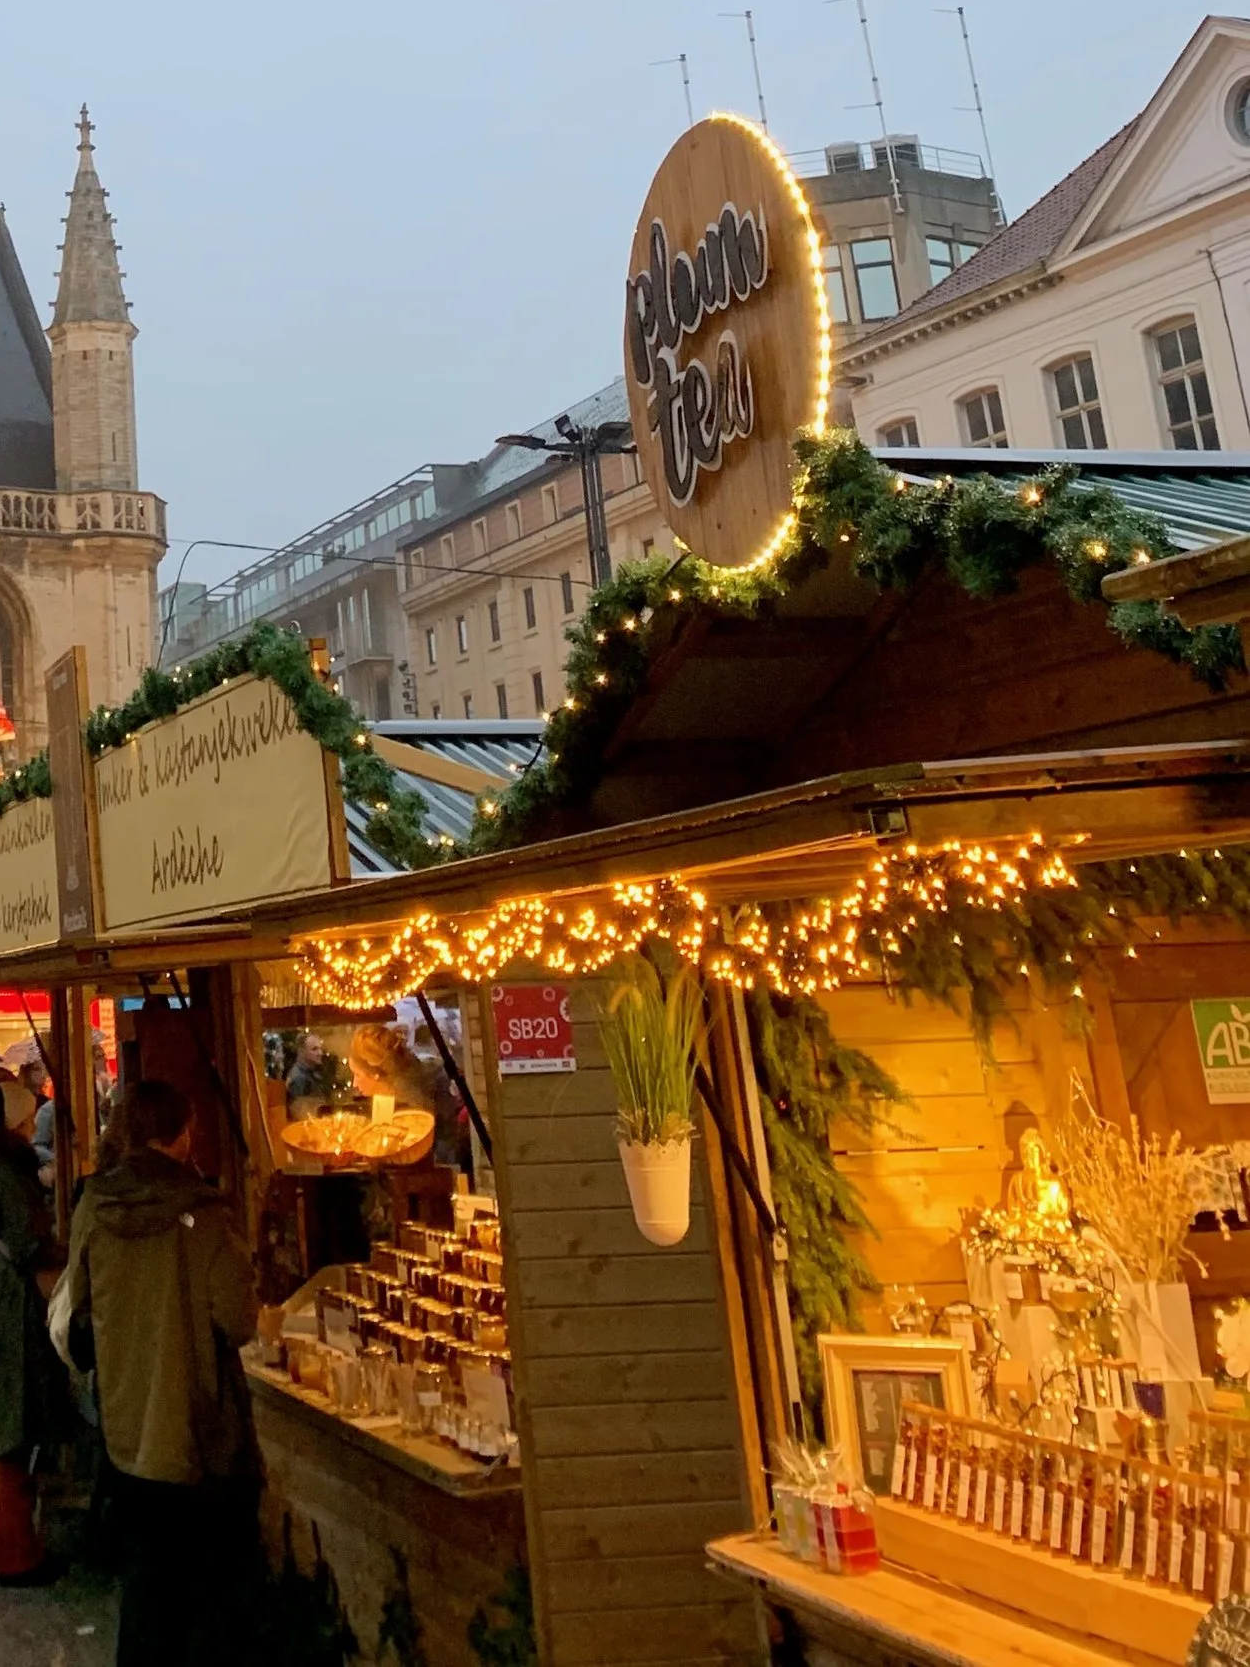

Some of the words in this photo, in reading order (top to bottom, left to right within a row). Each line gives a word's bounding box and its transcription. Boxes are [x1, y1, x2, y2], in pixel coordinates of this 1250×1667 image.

[627, 201, 768, 388] plum
[648, 329, 754, 509] tea
[138, 743, 149, 798] &
[154, 677, 297, 784] kastanjekweke
[152, 825, 225, 894] Ardèche
[508, 1017, 559, 1040] SB20
